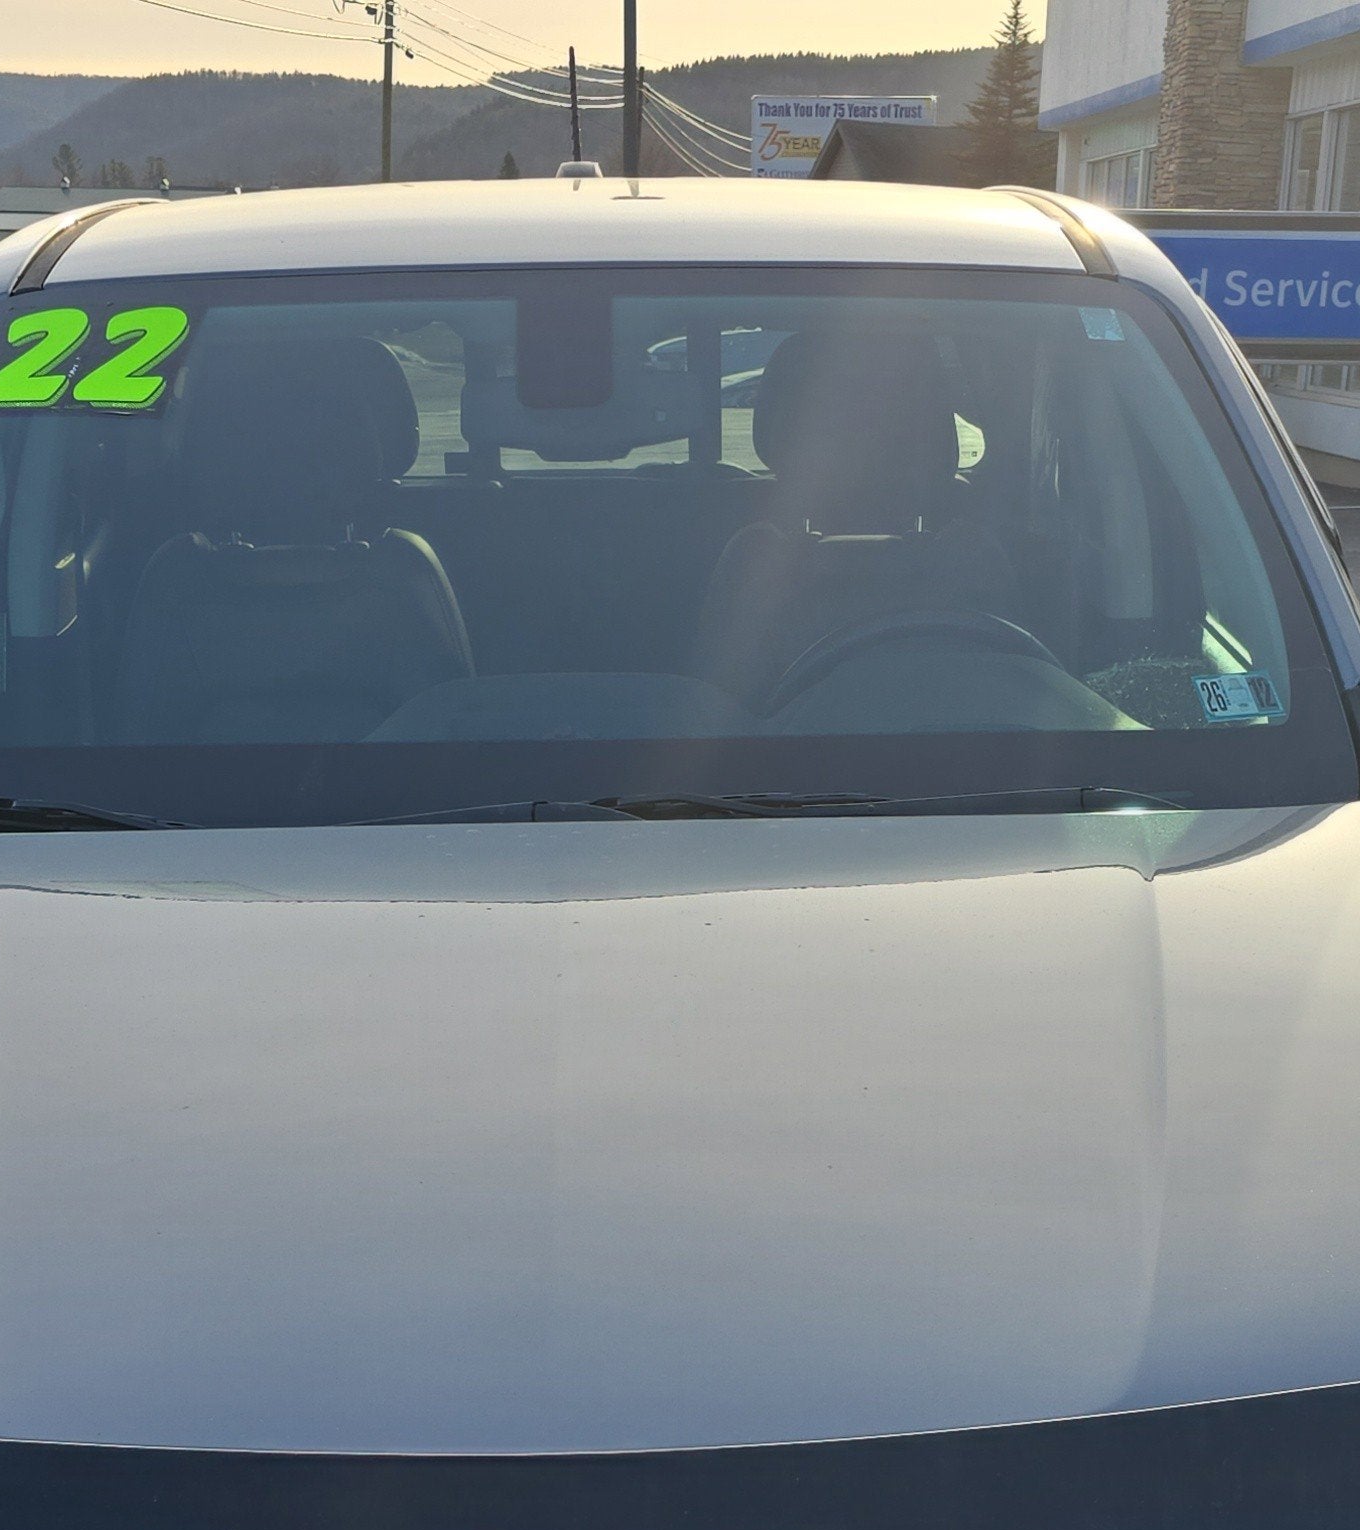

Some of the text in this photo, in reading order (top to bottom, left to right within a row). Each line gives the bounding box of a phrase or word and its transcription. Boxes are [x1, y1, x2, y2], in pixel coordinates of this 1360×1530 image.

[758, 102, 922, 119] Thank You for 75 Years of Trust
[758, 123, 790, 161] 75
[1200, 681, 1228, 712] 26
